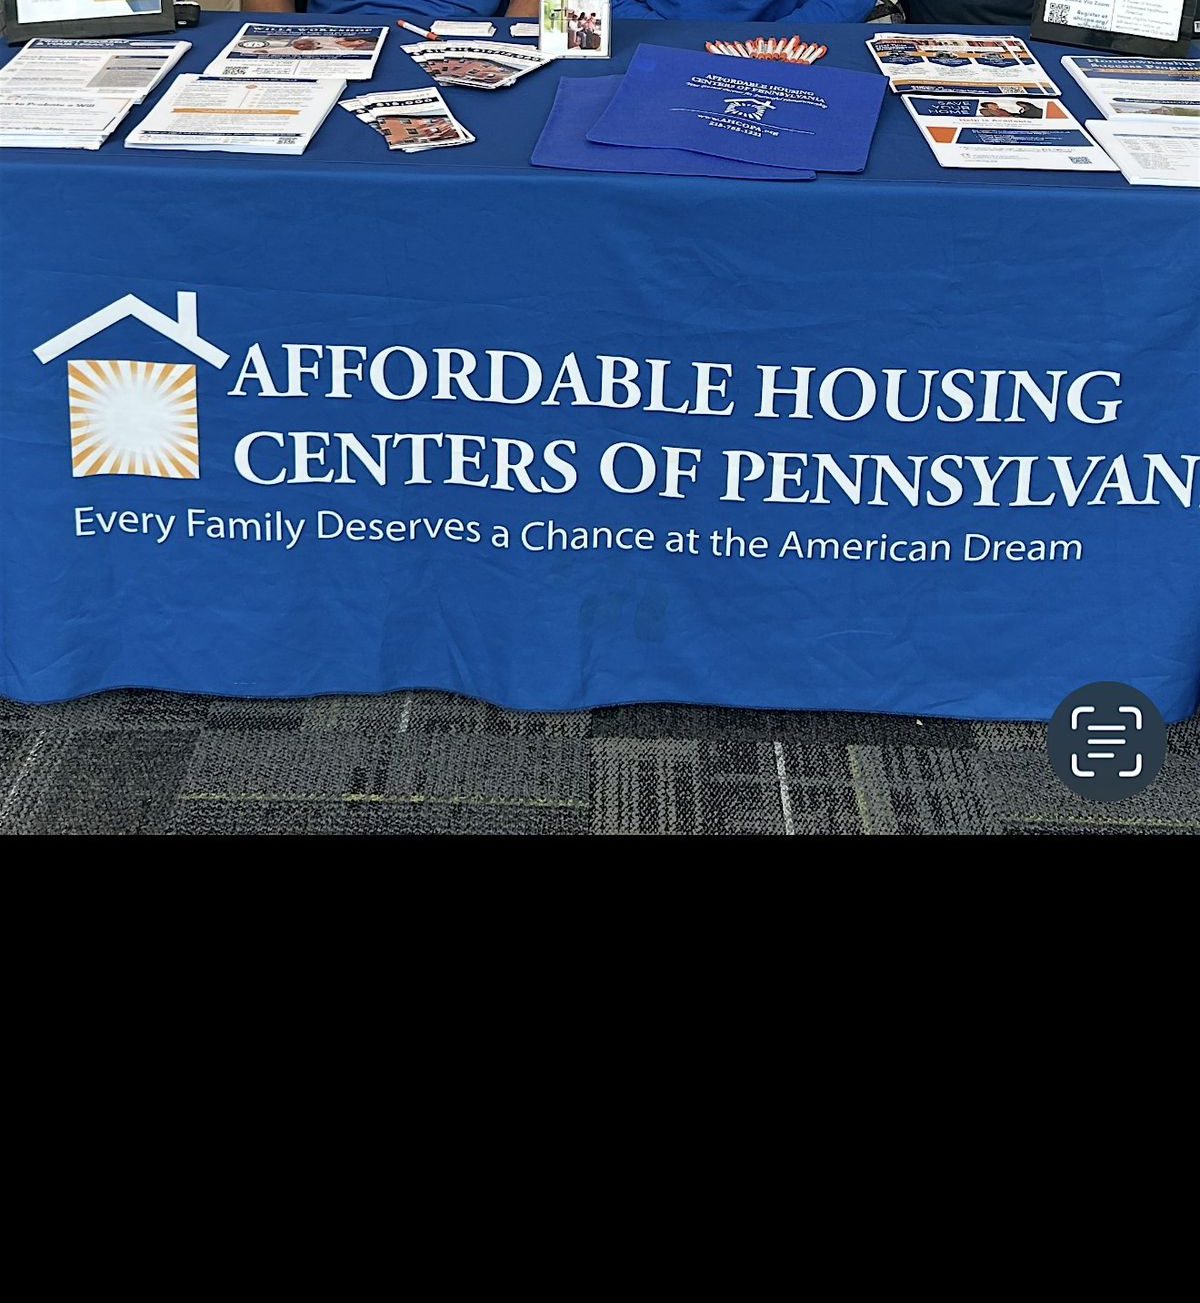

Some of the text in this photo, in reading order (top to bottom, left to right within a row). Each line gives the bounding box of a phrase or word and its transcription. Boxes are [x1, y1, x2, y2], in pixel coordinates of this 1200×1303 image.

[1077, 9, 1101, 18] Register
[1093, 0, 1110, 7] Zoom
[691, 76, 736, 89] CENTERS
[750, 85, 826, 104] PENNSYLVANIA
[705, 74, 768, 89] AFFORDABLE
[769, 85, 815, 97] HOUSING
[227, 342, 1123, 425] AFFORDABLE HOUSING
[233, 431, 579, 494] CENTERS
[599, 441, 702, 499] OF
[74, 506, 1083, 562] Every Family Deserves a Chance at the American Dream
